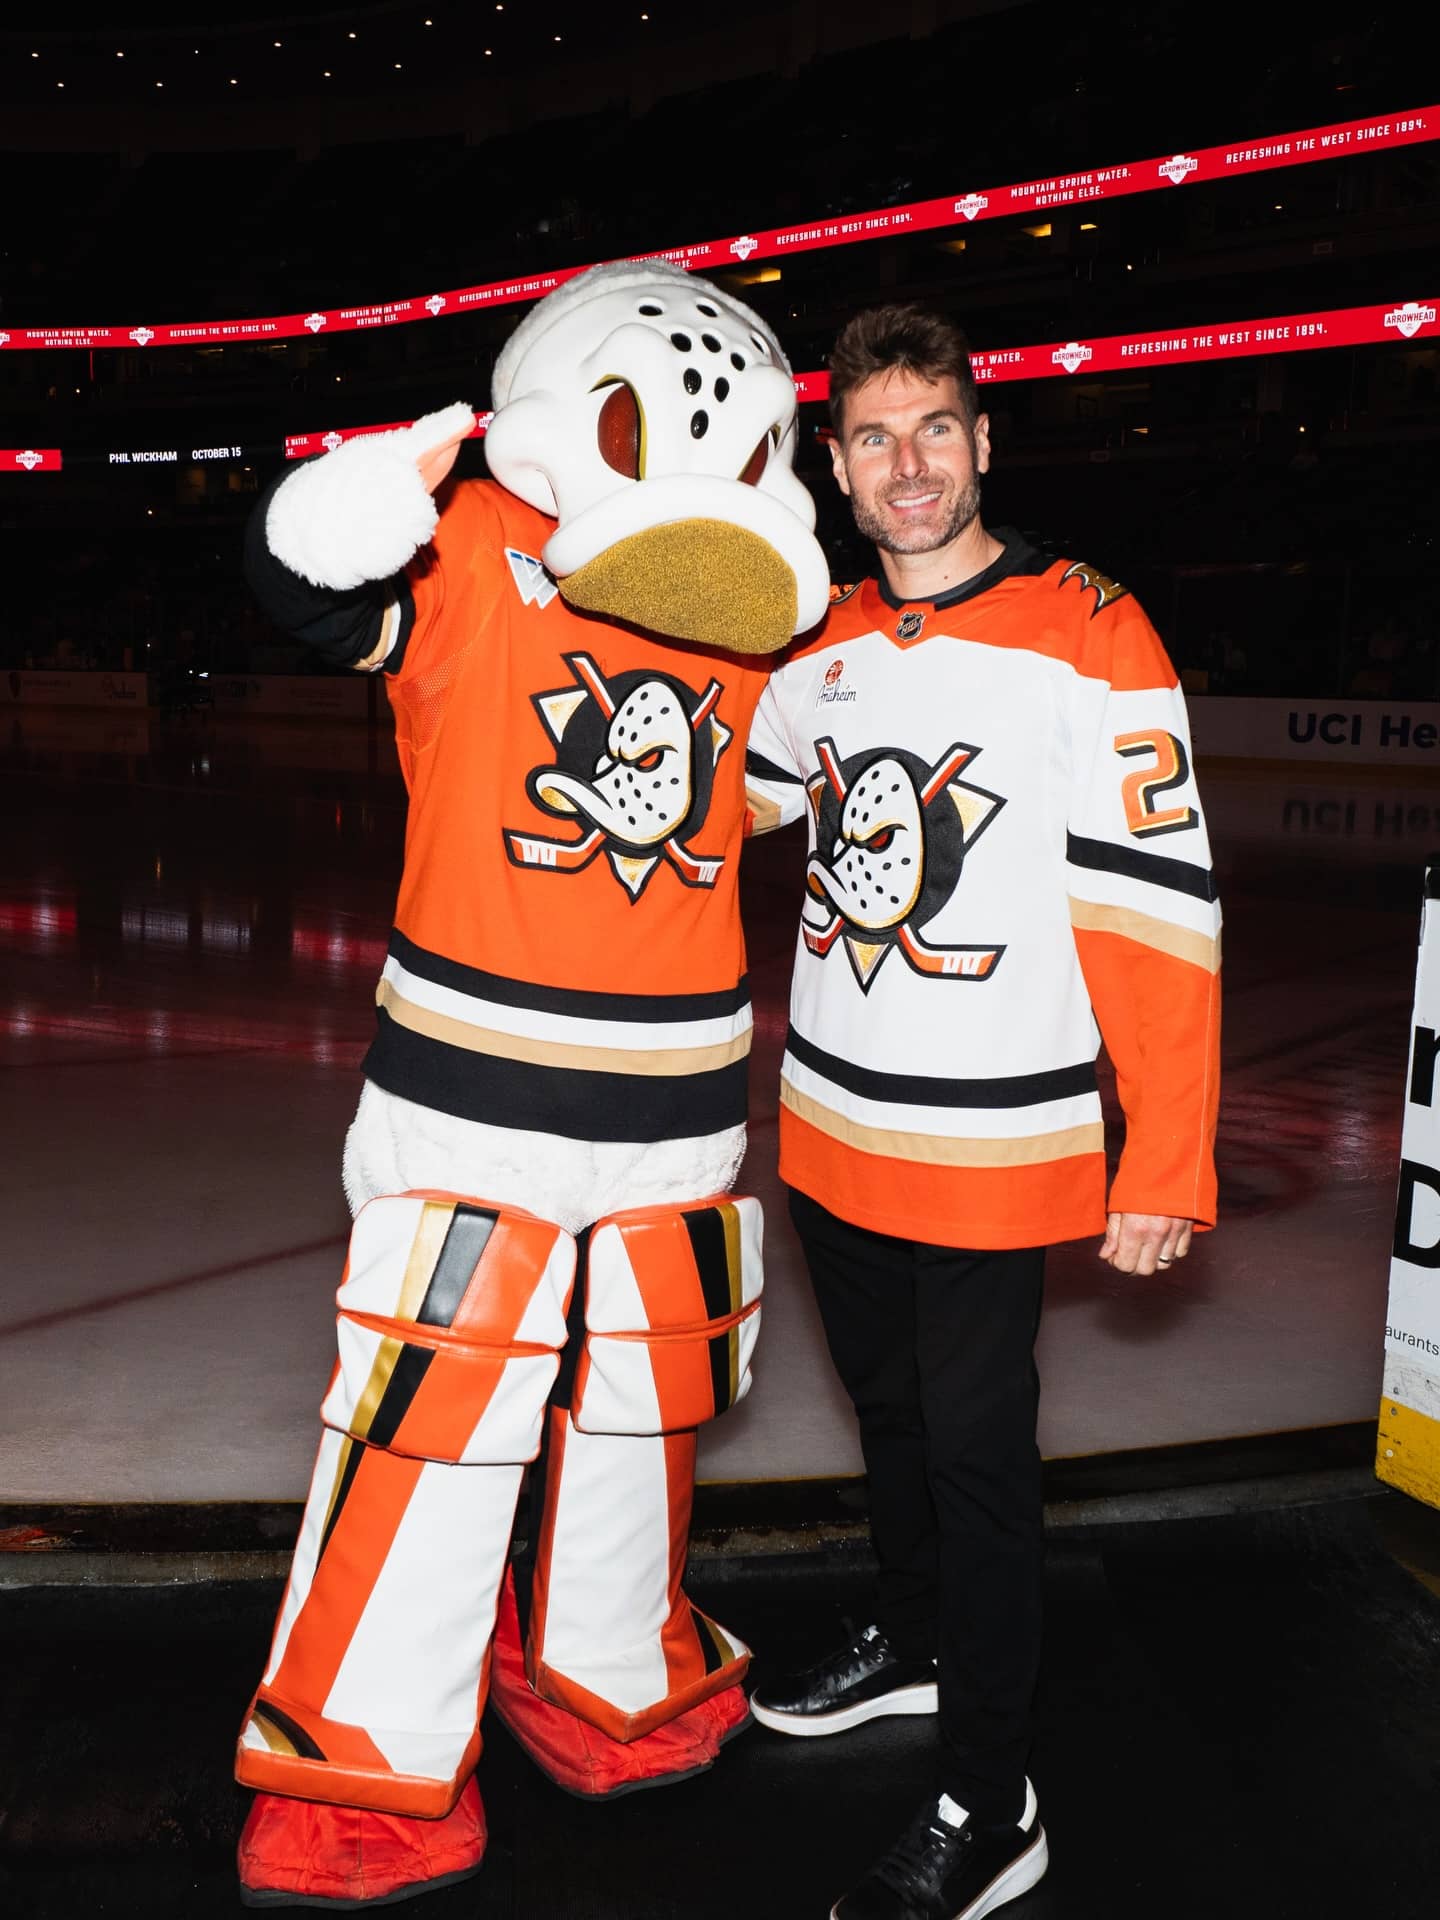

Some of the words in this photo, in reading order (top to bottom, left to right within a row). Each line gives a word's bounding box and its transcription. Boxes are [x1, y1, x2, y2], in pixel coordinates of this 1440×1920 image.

[1226, 143, 1291, 164] REFRESHING
[1296, 138, 1316, 151] THE
[1321, 132, 1352, 148] WEST
[1356, 124, 1391, 140] SINCE
[1395, 118, 1427, 133] 1894.
[1160, 161, 1197, 174] ARROWHEAD
[1010, 181, 1056, 198] MOUNTAIN
[1060, 174, 1092, 189] SPRING
[1097, 168, 1132, 181] WATER.
[1035, 191, 1074, 206] NOTHING
[1078, 186, 1104, 198] ELSE.
[776, 229, 821, 245] REFRESHING
[824, 226, 838, 237] THE
[841, 222, 863, 233] WEST
[865, 217, 889, 229] SINCE
[892, 212, 913, 224] 1894.
[687, 245, 712, 257] WATER.
[493, 287, 504, 296] THE
[505, 285, 521, 294] WEST
[523, 281, 540, 291] SINCE
[340, 308, 370, 320] MOUNTAIN
[1386, 311, 1434, 325] ARROWHEAD
[209, 327, 220, 335] THE
[1121, 337, 1188, 356] REFRESHING
[1193, 335, 1213, 349] THE
[1219, 331, 1250, 346] WEST
[1255, 326, 1290, 341] SINCE
[1295, 322, 1328, 337] 1894.
[989, 351, 1025, 365] WATER.
[1053, 350, 1091, 362] ARROWHEAD
[972, 368, 996, 380] LSE.
[109, 453, 131, 463] PHIL
[131, 451, 178, 462] WICKHAM
[192, 447, 229, 460] OCTOBER
[231, 446, 242, 457] 15
[1288, 712, 1362, 745] UCI
[1113, 728, 1199, 840] 2
